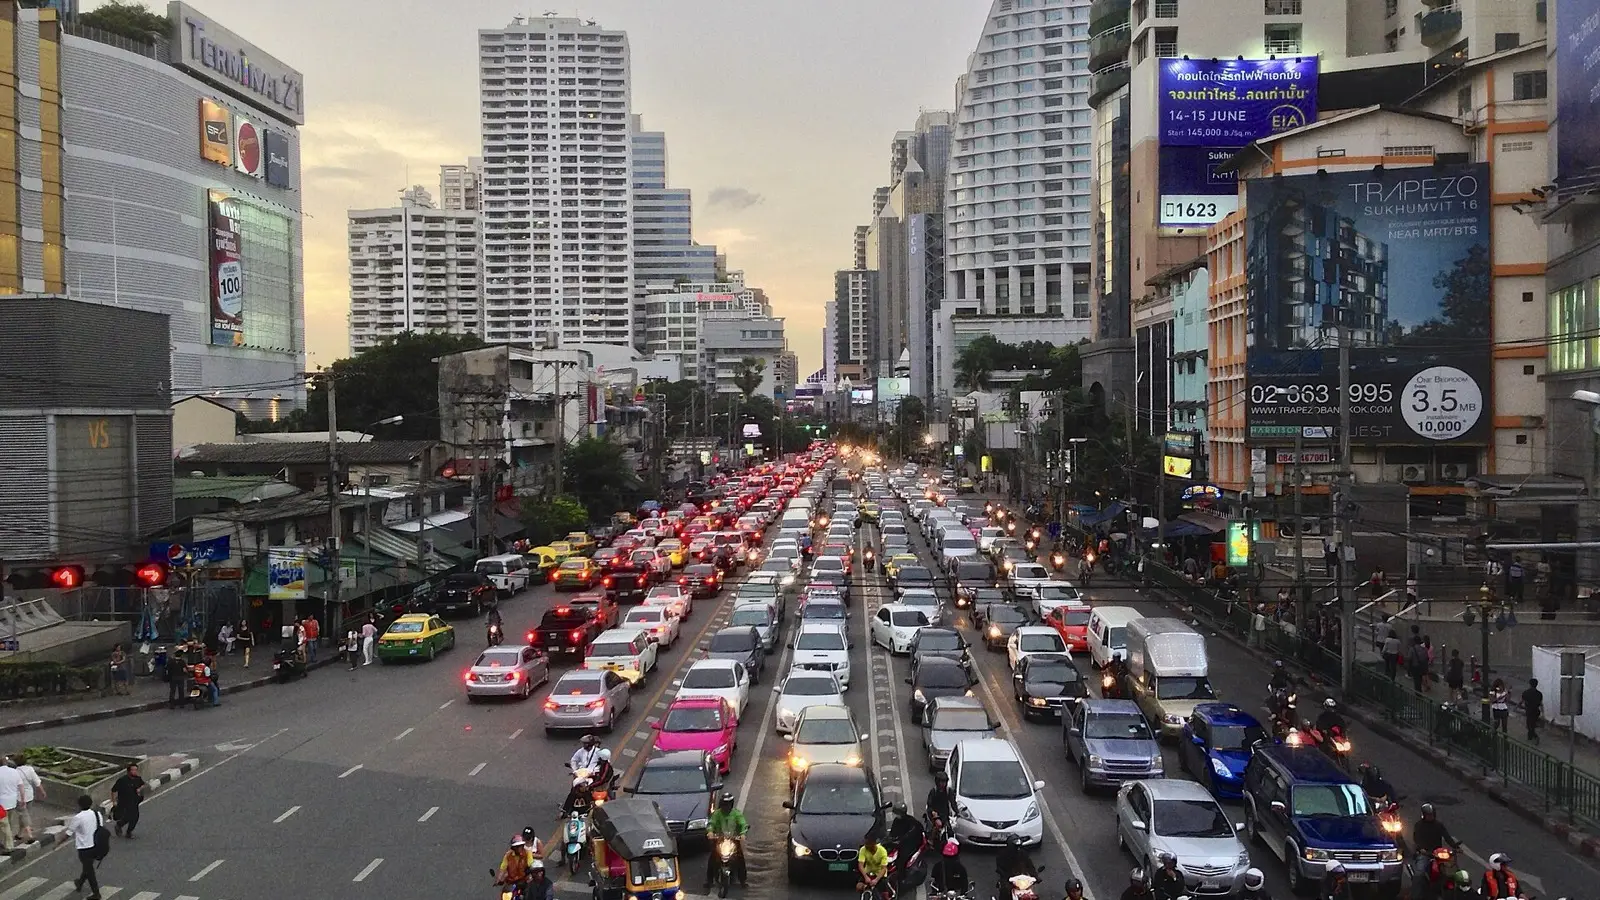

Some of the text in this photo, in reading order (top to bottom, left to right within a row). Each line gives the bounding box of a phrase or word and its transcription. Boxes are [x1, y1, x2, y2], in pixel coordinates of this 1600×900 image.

[185, 17, 302, 115] TERMINAL 21
[1169, 110, 1247, 121] 14-15 JUNE
[1272, 115, 1299, 127] EIA
[1187, 128, 1221, 137] 145,000
[1349, 175, 1478, 203] TRAPEZO
[1176, 203, 1217, 217] 1623
[1364, 200, 1478, 216] SUKHUMVIT 16
[1388, 225, 1478, 240] NEAR MRT/BTS
[221, 277, 240, 295] 100
[1251, 384, 1278, 404] 02
[1335, 383, 1393, 403] 995
[1412, 389, 1476, 412] 3.5 MB
[1250, 405, 1393, 415] WWW.TRAPEZOBANKOK.COM
